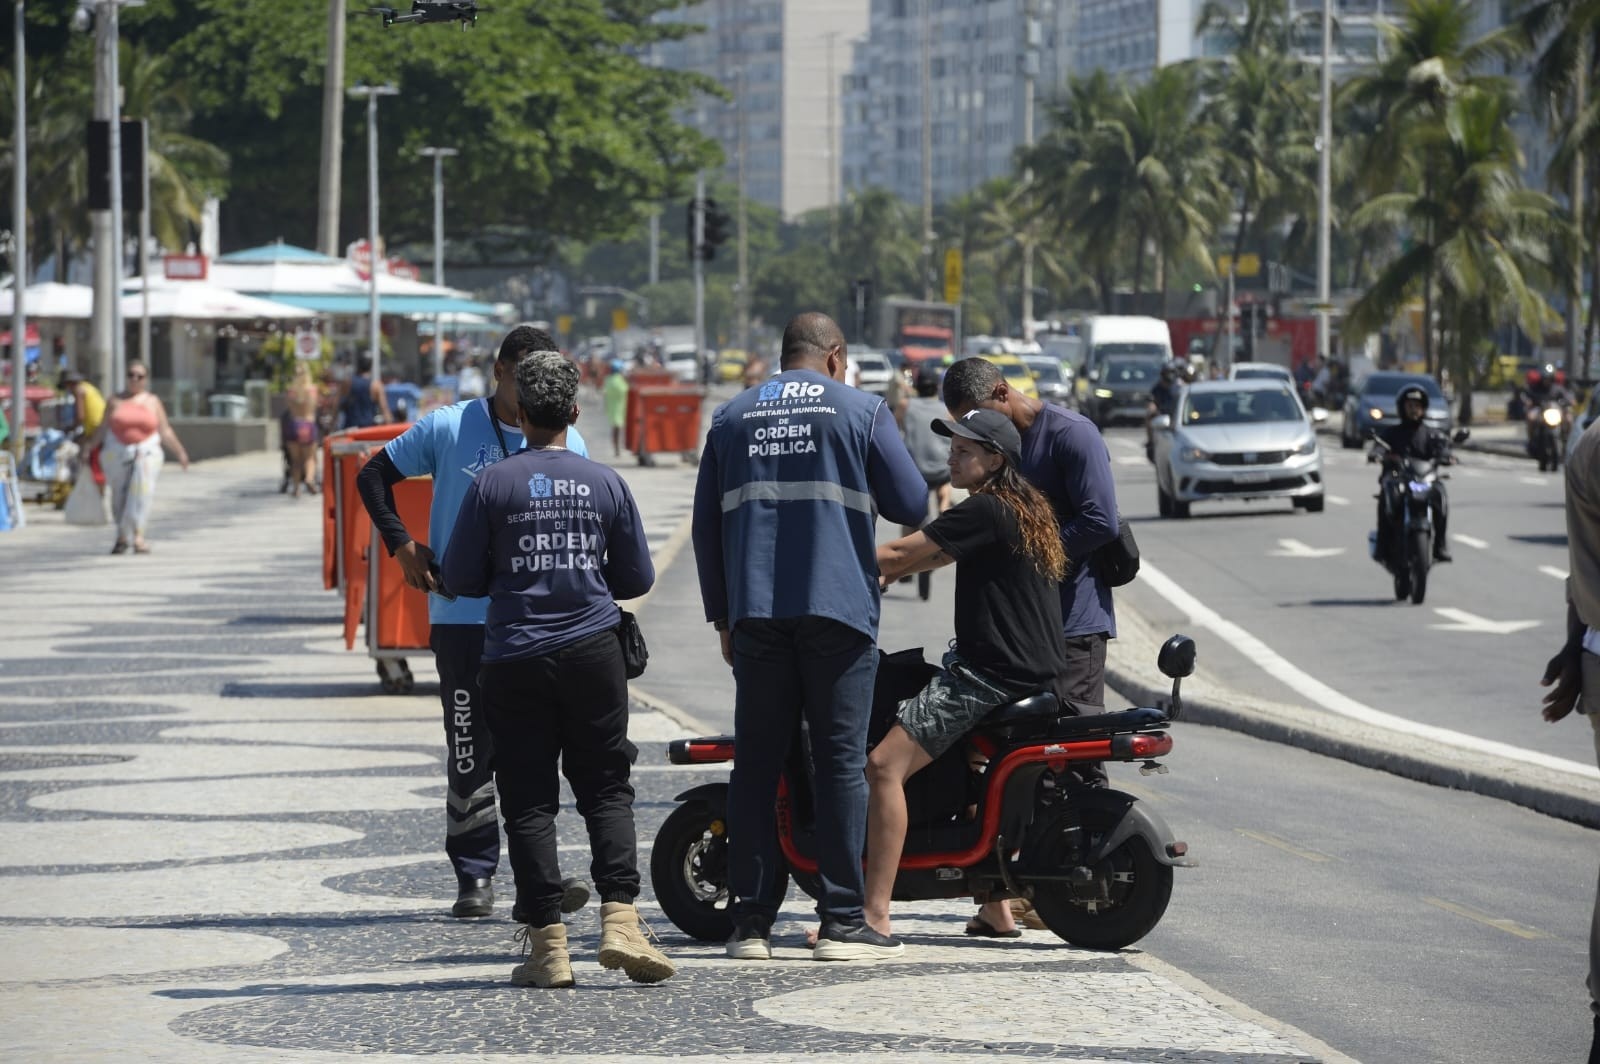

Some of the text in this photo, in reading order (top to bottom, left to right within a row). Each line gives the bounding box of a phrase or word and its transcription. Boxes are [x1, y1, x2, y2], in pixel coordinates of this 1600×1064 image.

[782, 381, 825, 398] Rio
[756, 398, 821, 408] PREFEITURA
[742, 406, 837, 419] SECRETARIA MUNICIPAL
[754, 424, 811, 440] ORDEM
[748, 440, 817, 457] PÚBLICA
[554, 479, 591, 496] Rio
[529, 500, 591, 508] PREFEITURA
[507, 511, 603, 524] SECRETARIA MUNICIPAL
[554, 521, 566, 530] DE
[518, 533, 597, 551] ORDEM
[511, 552, 599, 573] PÚBLICA
[454, 688, 475, 774] CET-RIO
